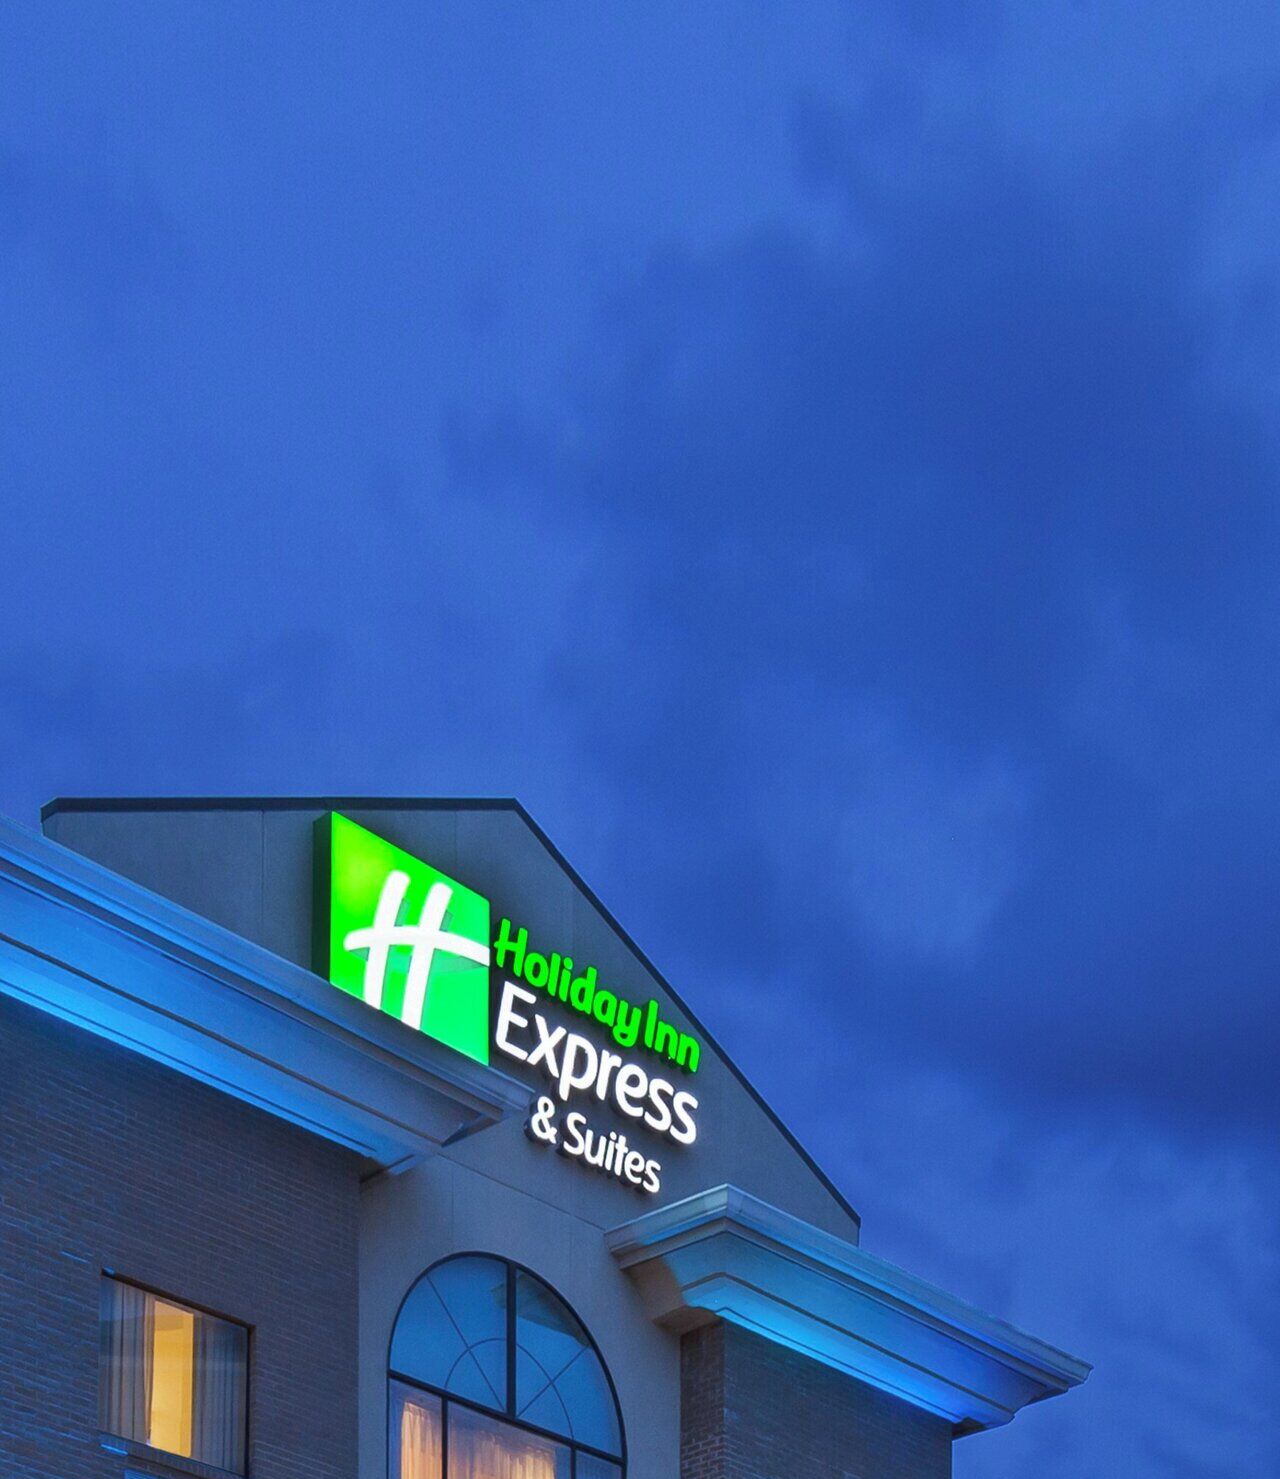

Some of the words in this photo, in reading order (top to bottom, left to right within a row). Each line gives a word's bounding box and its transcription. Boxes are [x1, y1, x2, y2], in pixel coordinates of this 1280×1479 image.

[494, 918, 641, 1048] Holiday
[644, 1000, 701, 1073] Inn
[495, 981, 700, 1145] Express
[530, 1096, 557, 1144] &
[563, 1112, 662, 1194] Suites
